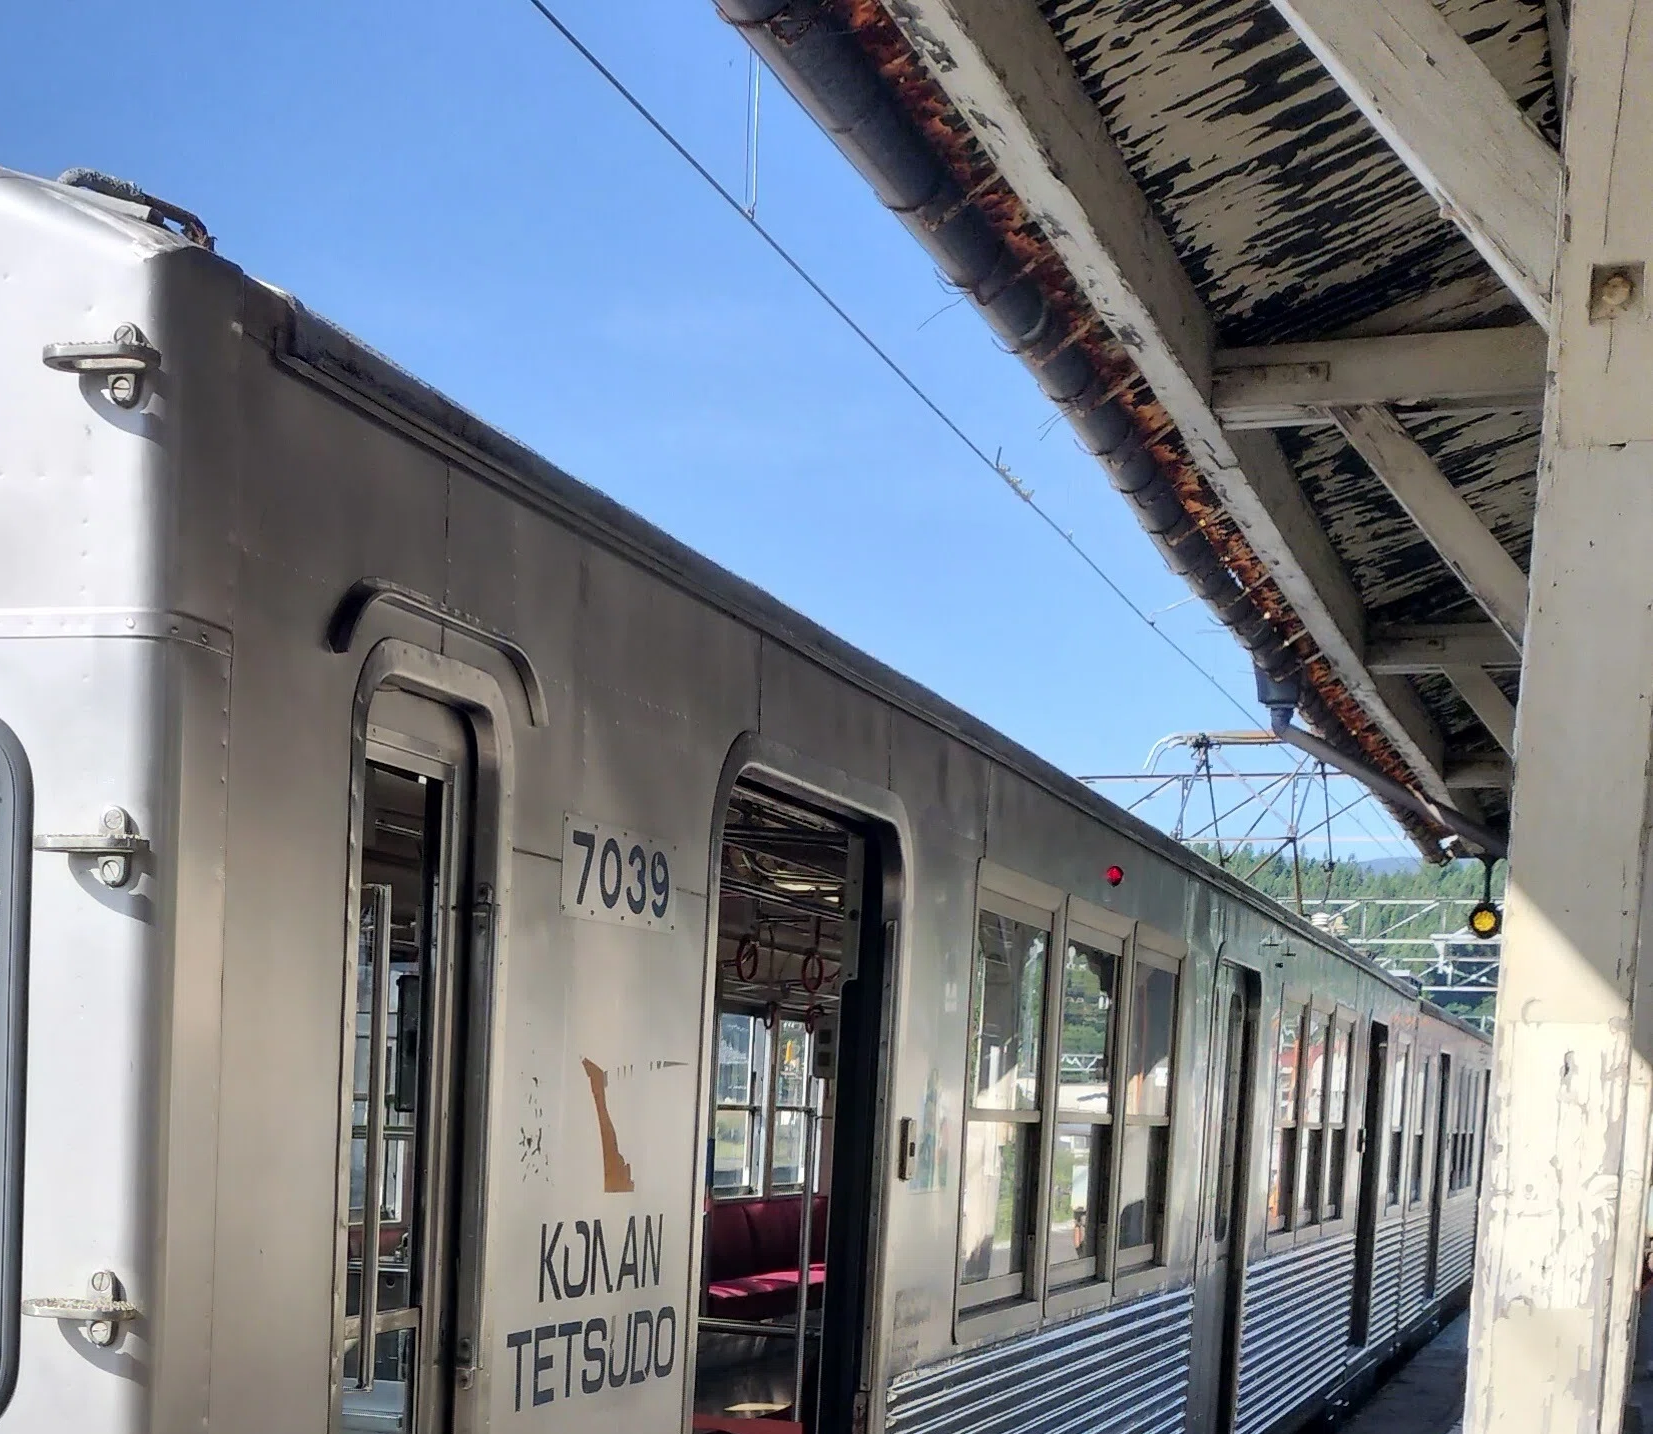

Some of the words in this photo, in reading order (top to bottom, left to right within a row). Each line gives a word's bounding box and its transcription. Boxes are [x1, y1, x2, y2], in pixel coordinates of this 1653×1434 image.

[572, 829, 670, 919] 7039
[538, 1213, 664, 1303] KONAN
[506, 1305, 677, 1413] TETSUDO
